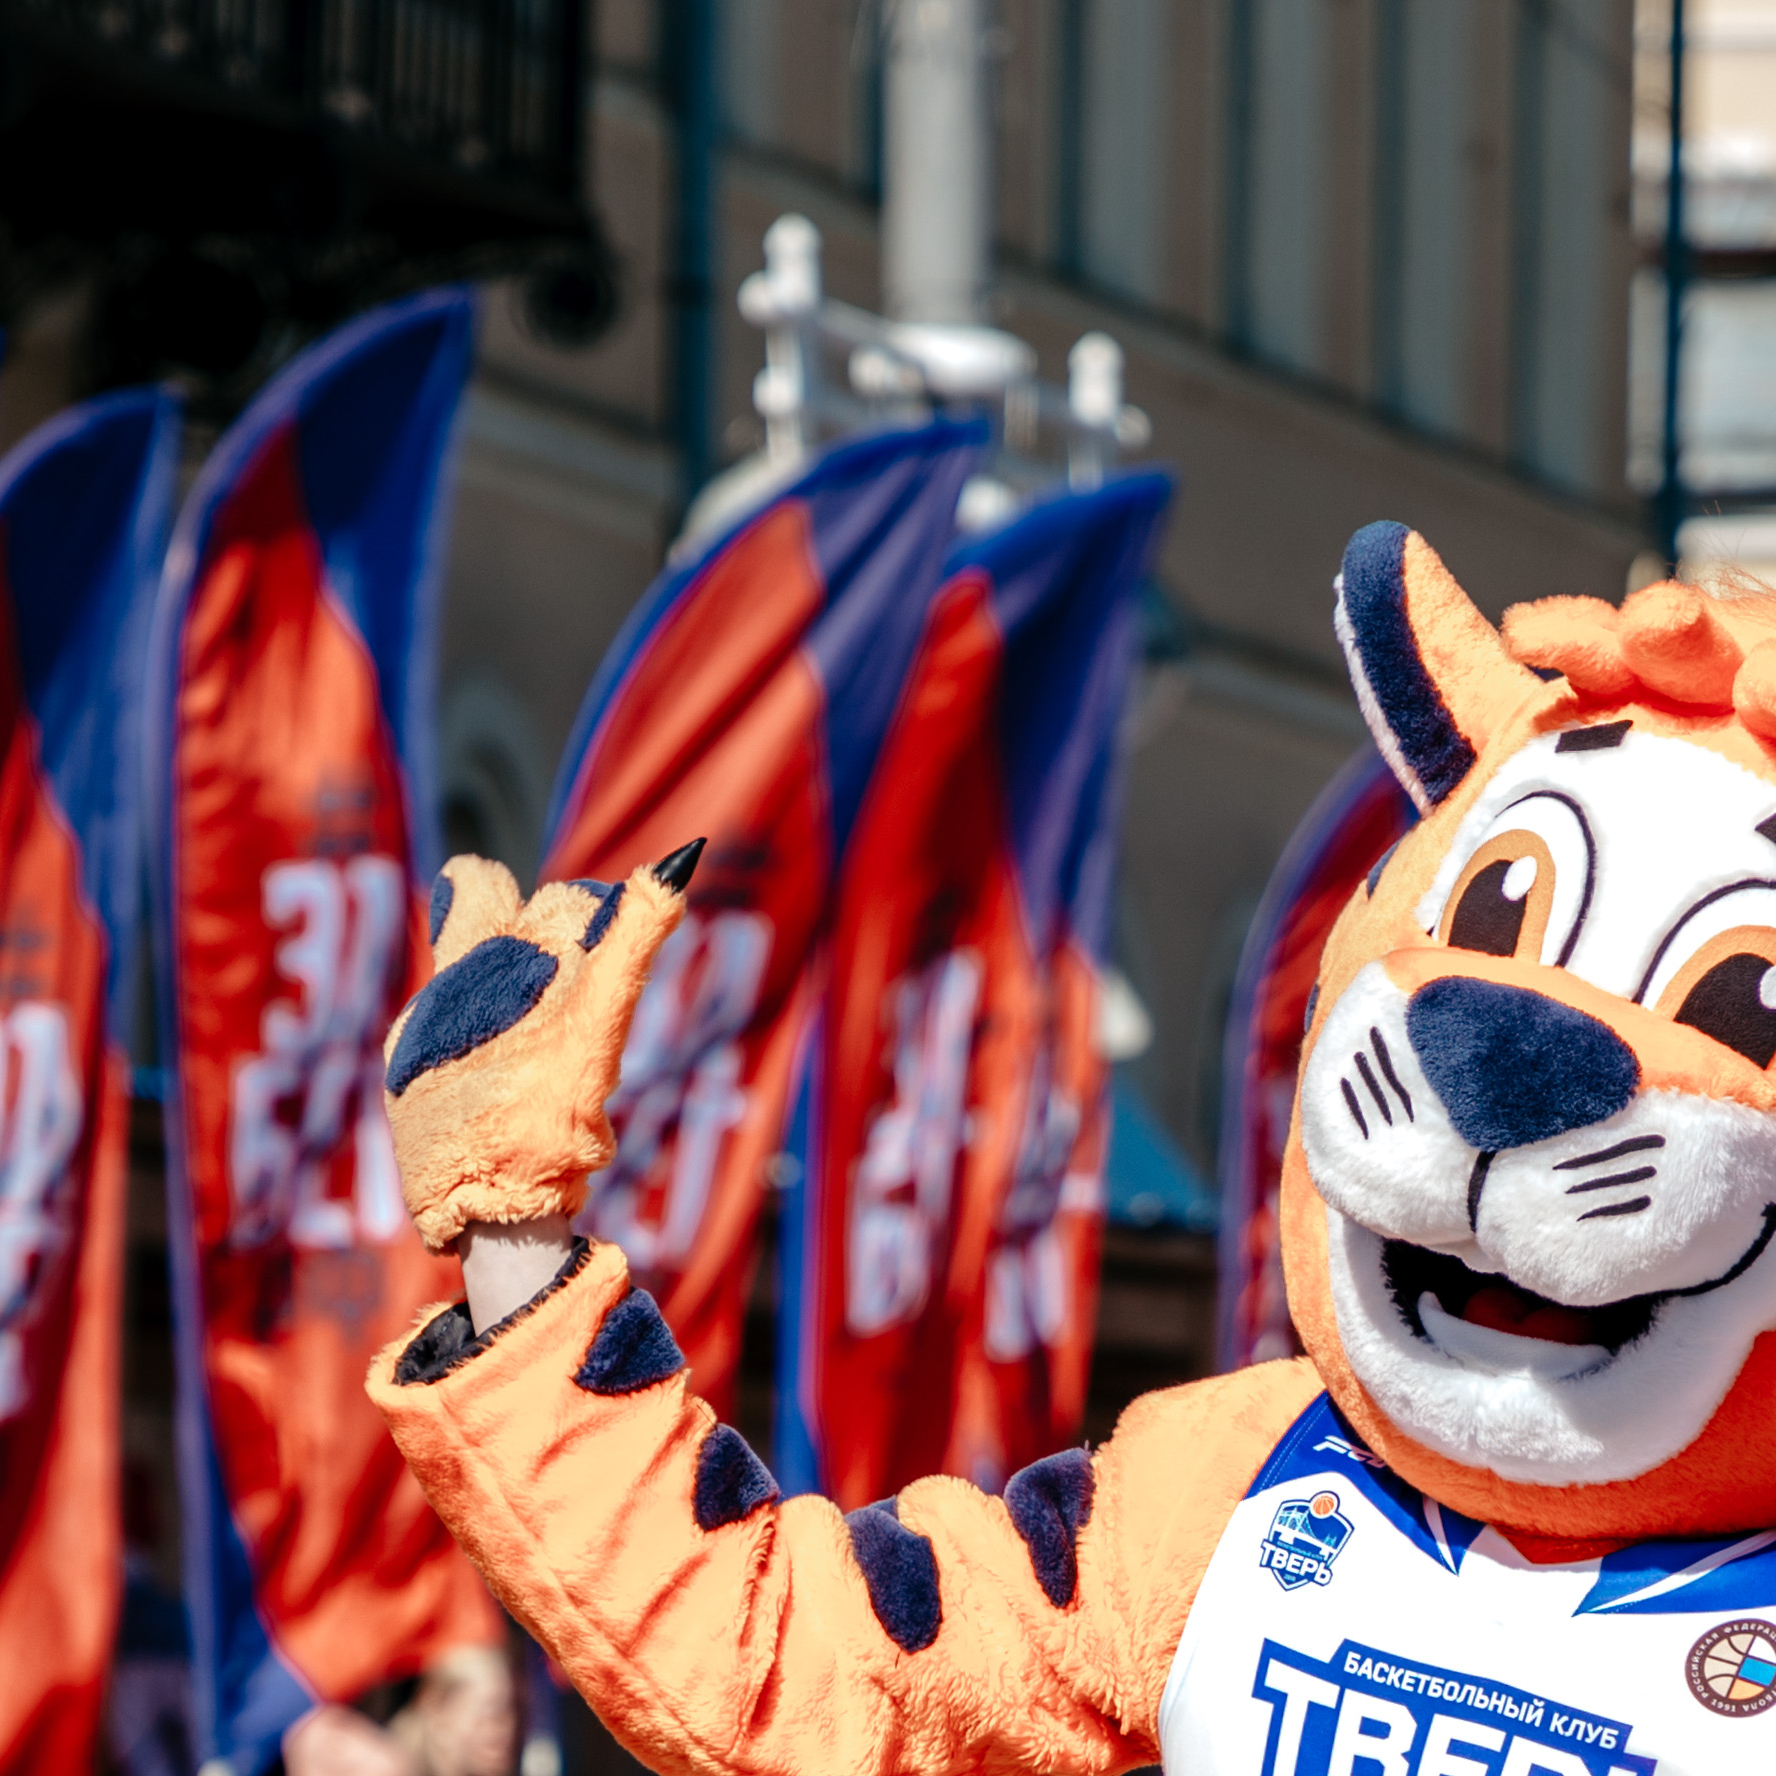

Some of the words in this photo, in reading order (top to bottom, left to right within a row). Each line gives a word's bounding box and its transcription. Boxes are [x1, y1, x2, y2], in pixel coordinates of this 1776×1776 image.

[1261, 1540, 1332, 1585] ТВЕРЬ
[1343, 1650, 1546, 1728] БАСКЕТБОЛЬНЫЙ
[1549, 1710, 1620, 1750] КЛУБ
